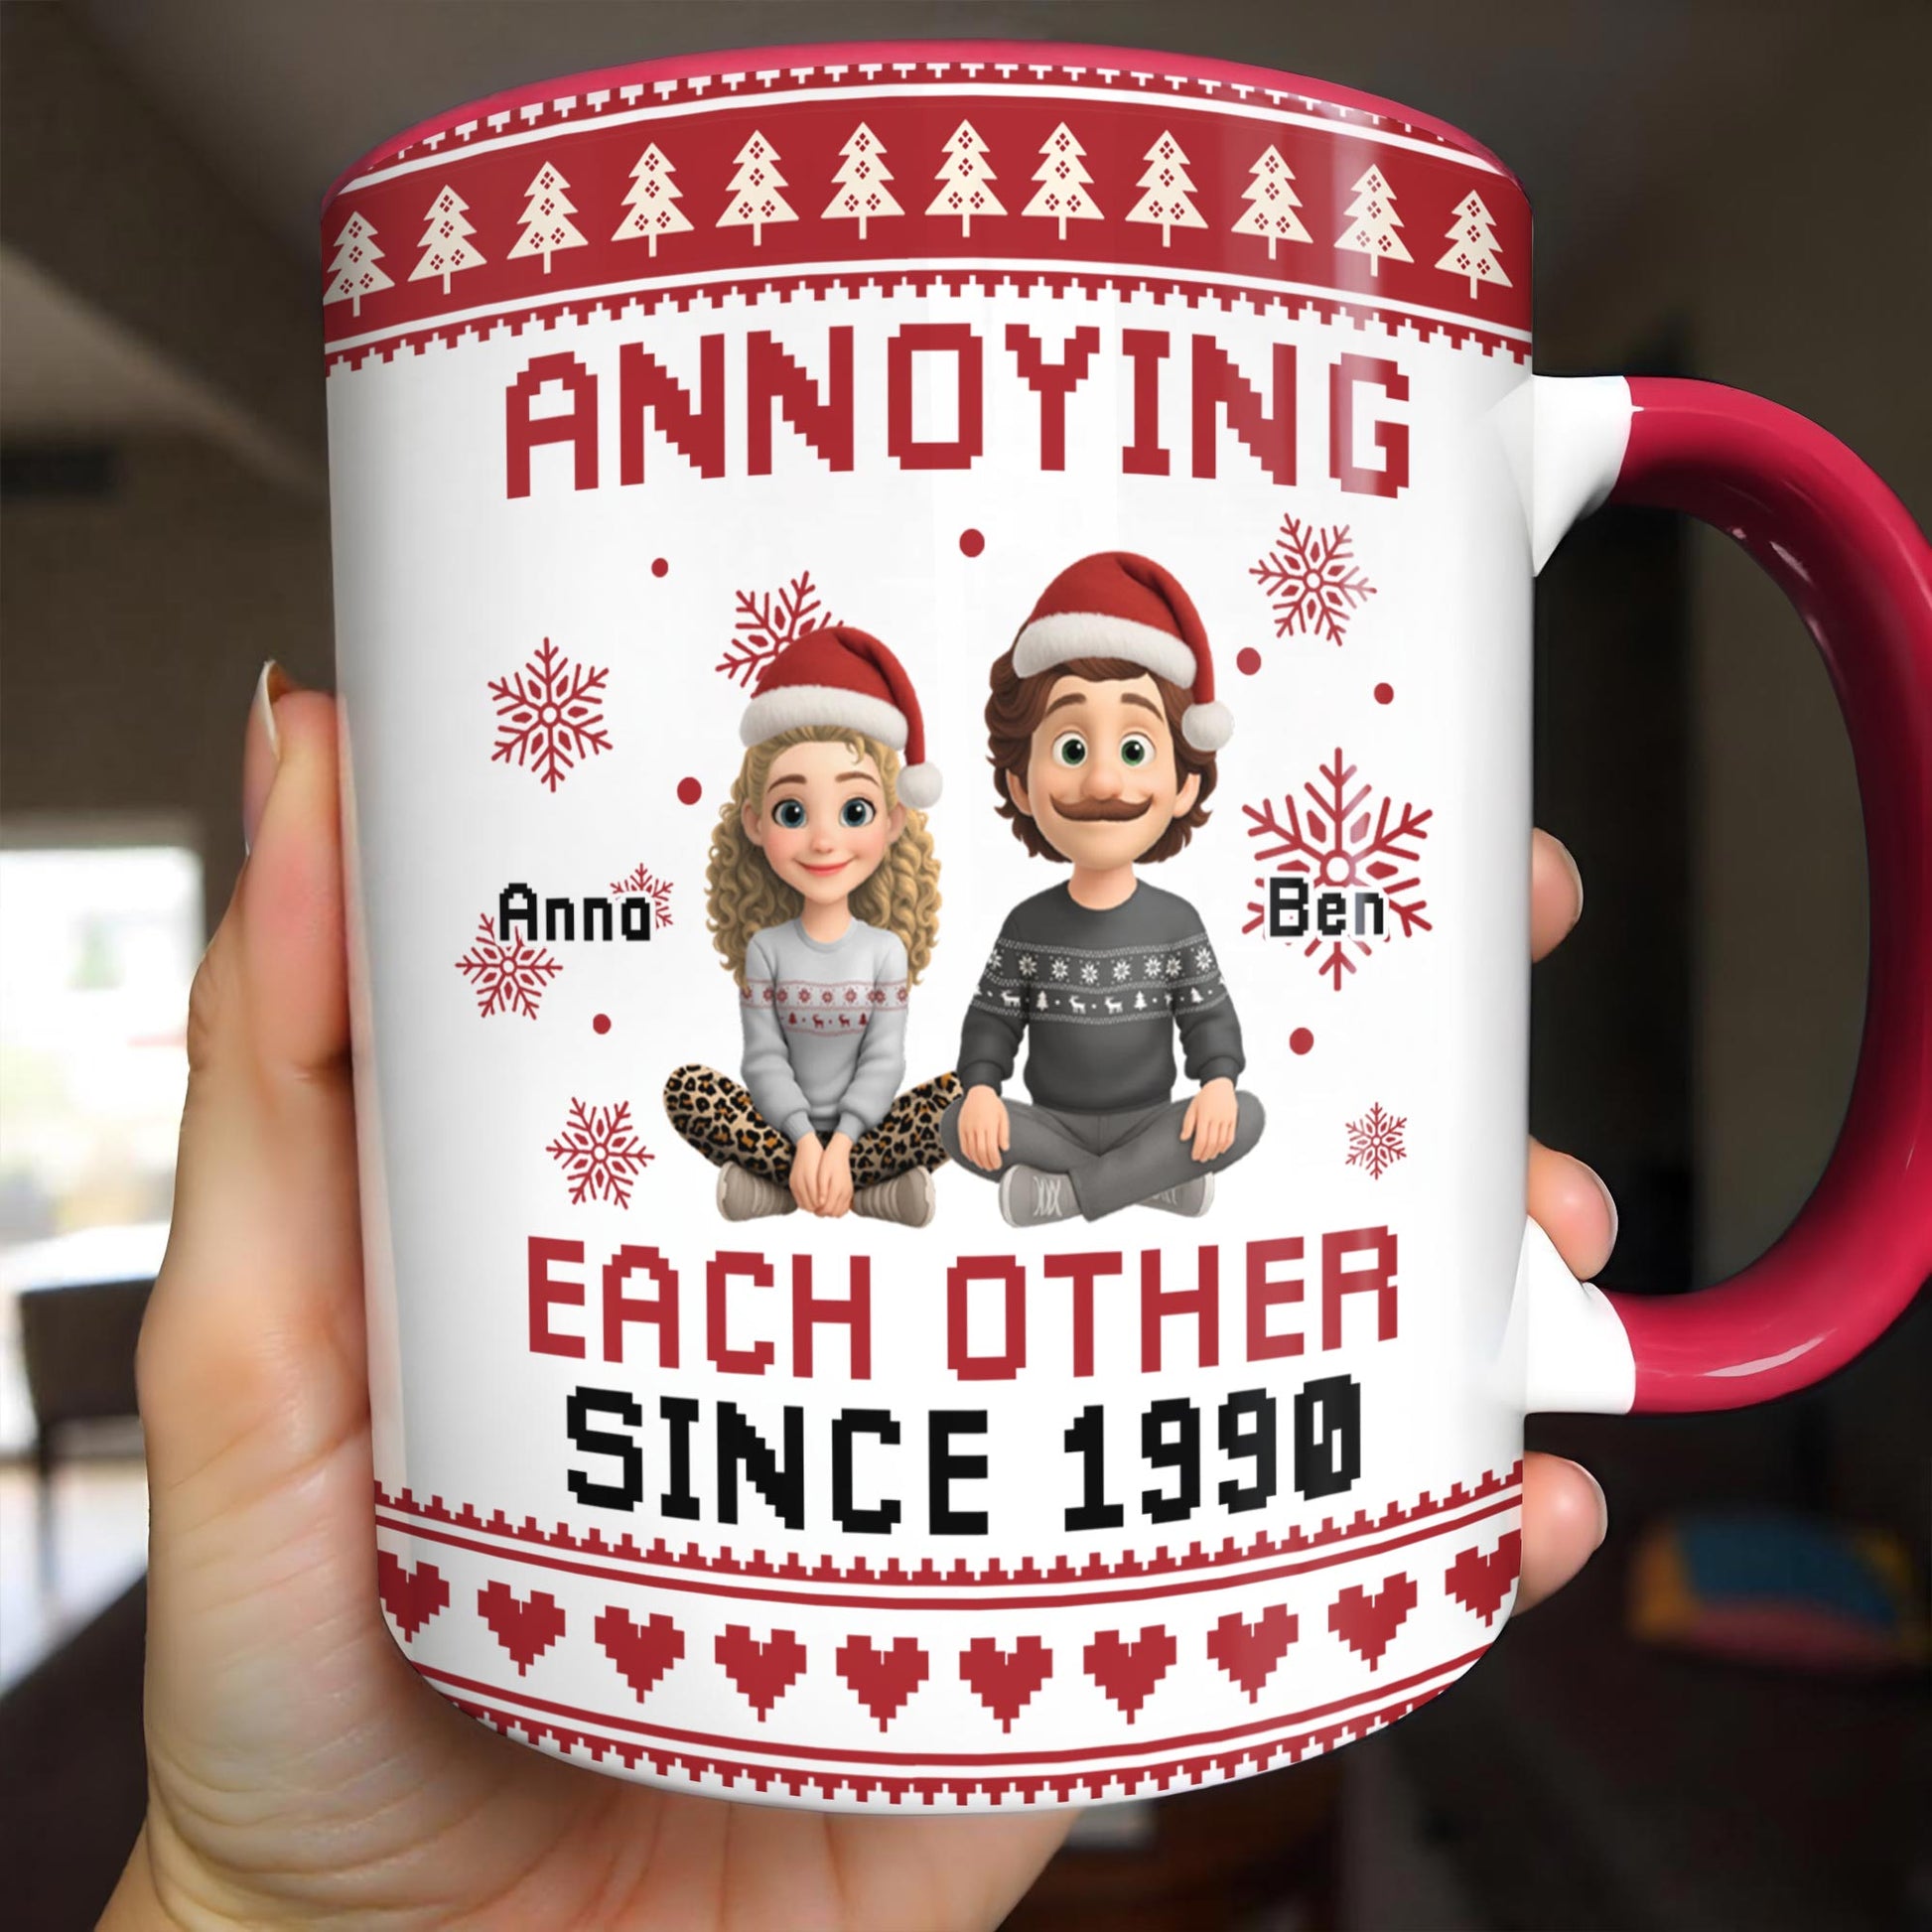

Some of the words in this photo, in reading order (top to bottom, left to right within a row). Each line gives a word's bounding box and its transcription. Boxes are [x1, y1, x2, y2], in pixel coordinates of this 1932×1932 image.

[506, 323, 1409, 499] ANNOYING
[1270, 877, 1384, 936] Ben
[528, 1237, 871, 1380] EACH
[947, 1226, 1399, 1382] OTHER
[567, 1386, 988, 1536] SINCE
[1064, 1375, 1360, 1531] 1990
